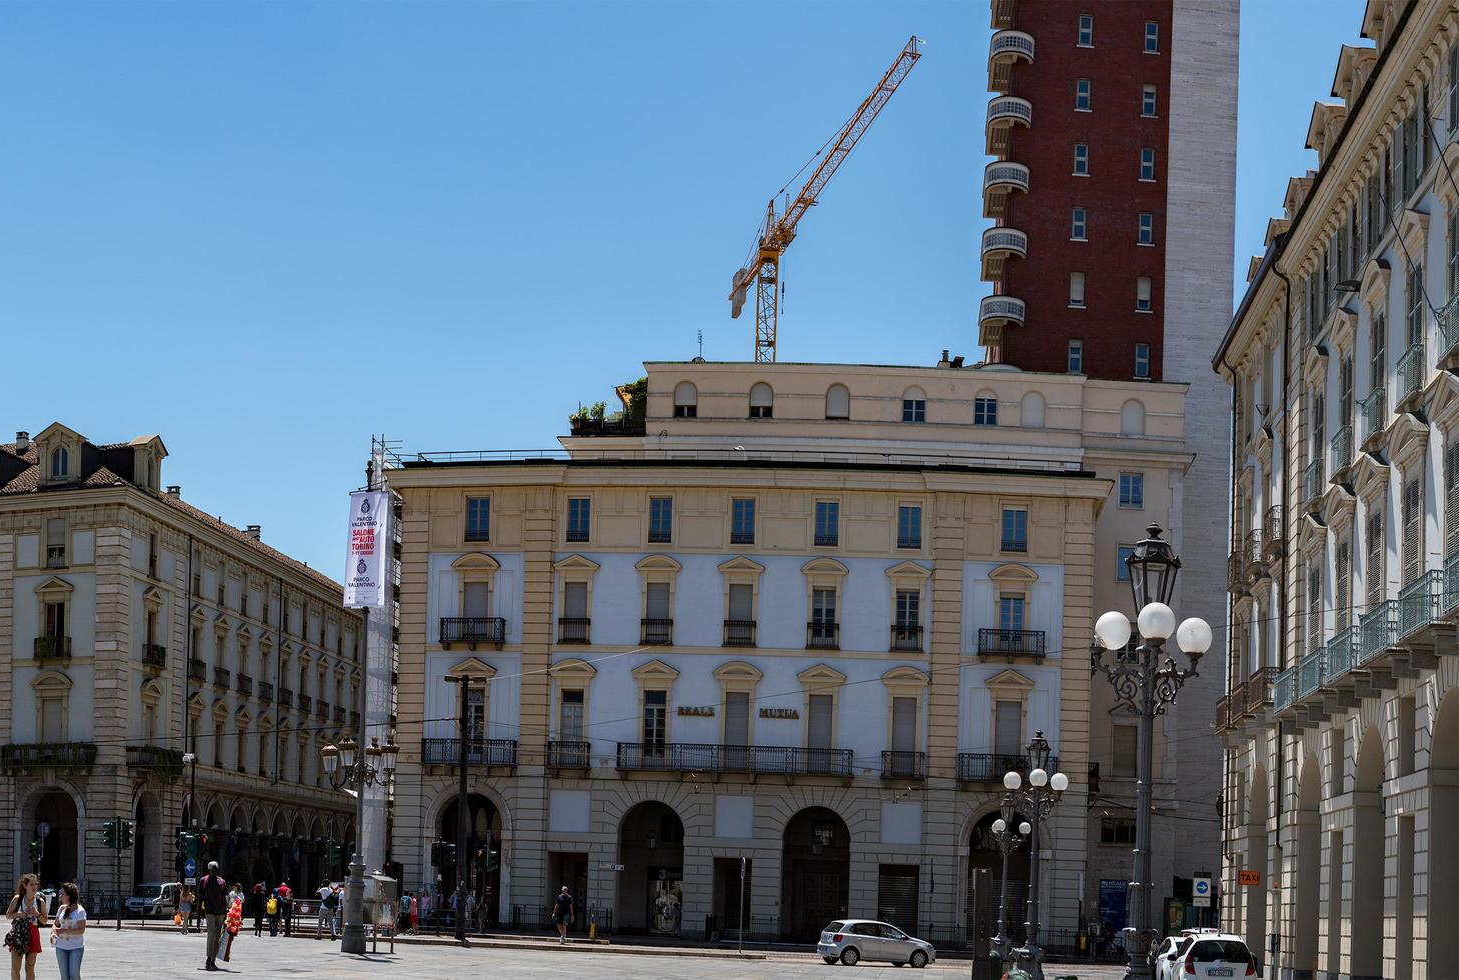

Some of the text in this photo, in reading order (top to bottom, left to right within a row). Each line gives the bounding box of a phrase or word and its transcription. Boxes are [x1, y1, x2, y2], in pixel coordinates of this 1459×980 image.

[677, 706, 715, 717] REALE
[759, 708, 799, 720] MUTUA
[1240, 872, 1260, 882] TAXI
